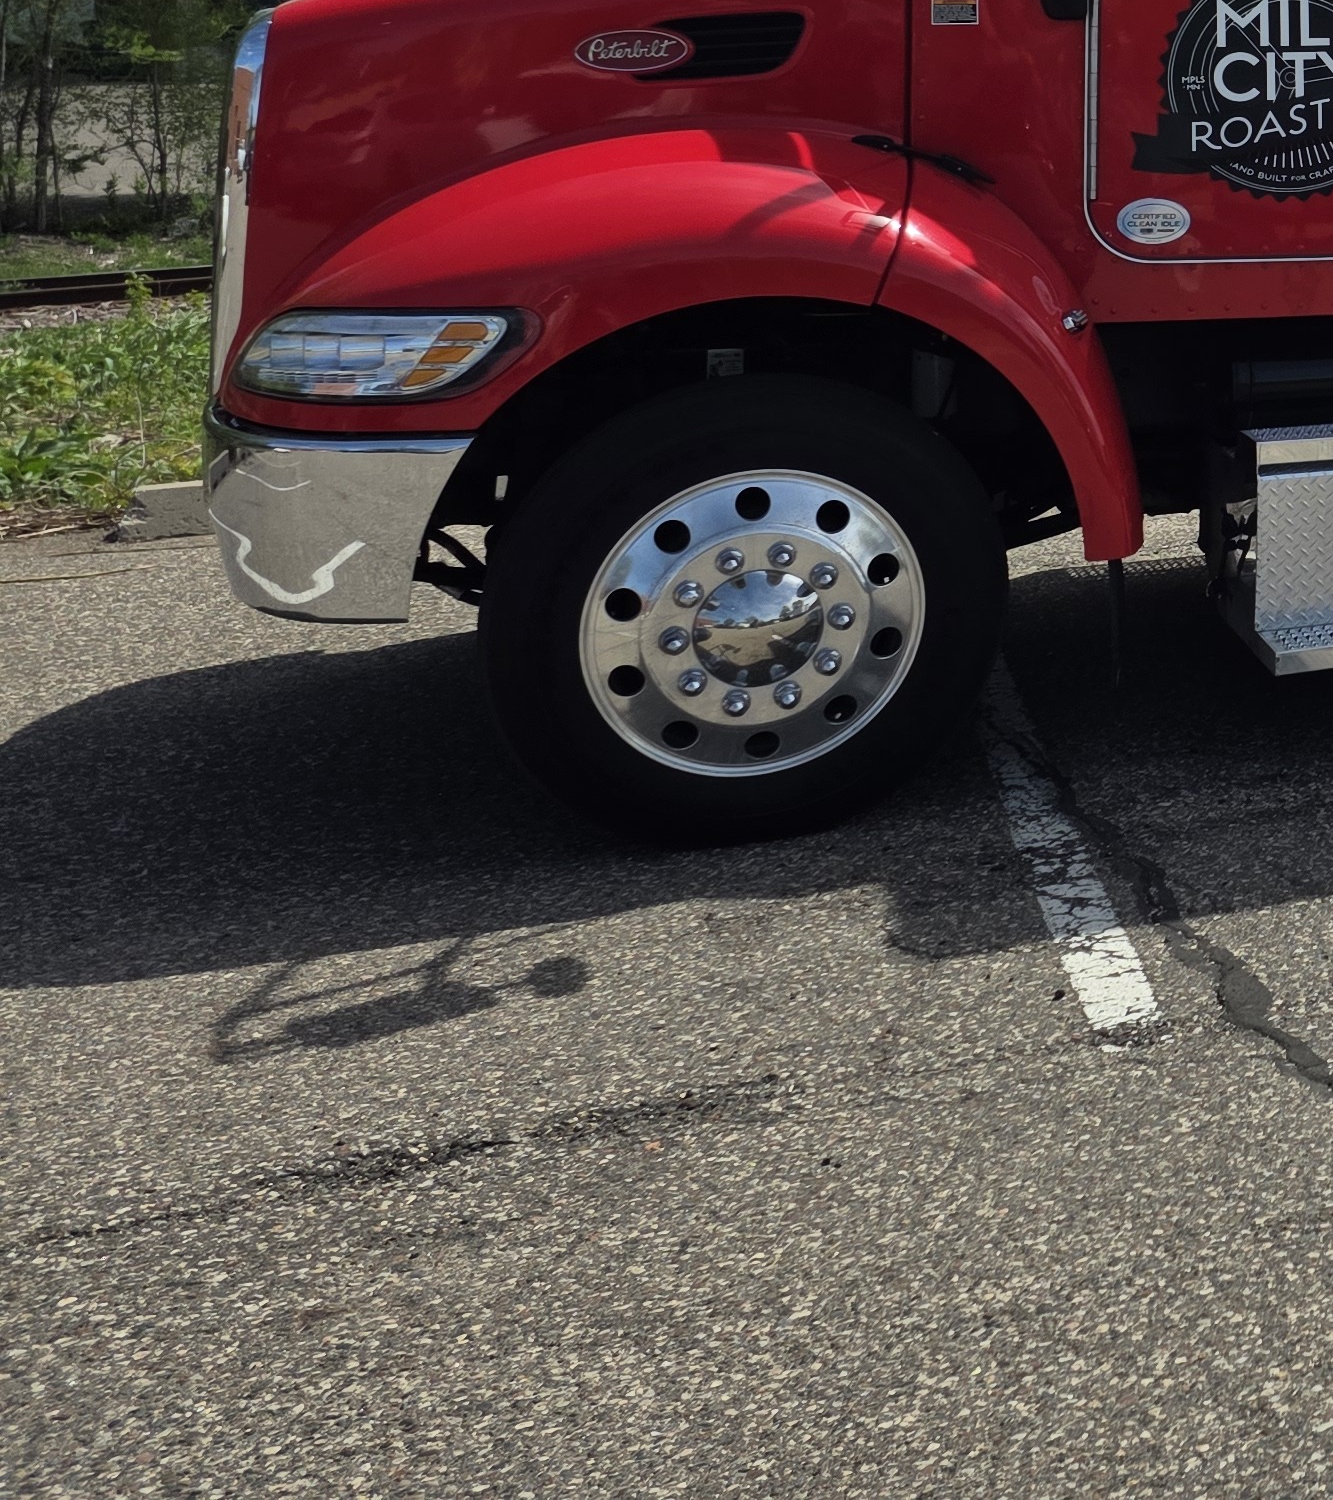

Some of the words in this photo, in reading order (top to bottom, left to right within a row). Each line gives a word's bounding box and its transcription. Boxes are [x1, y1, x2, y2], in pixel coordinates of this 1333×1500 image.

[588, 38, 677, 62] Peterbilt
[1181, 75, 1206, 84] MPLS
[1229, 162, 1254, 176] AND
[1257, 171, 1287, 182] BUILT
